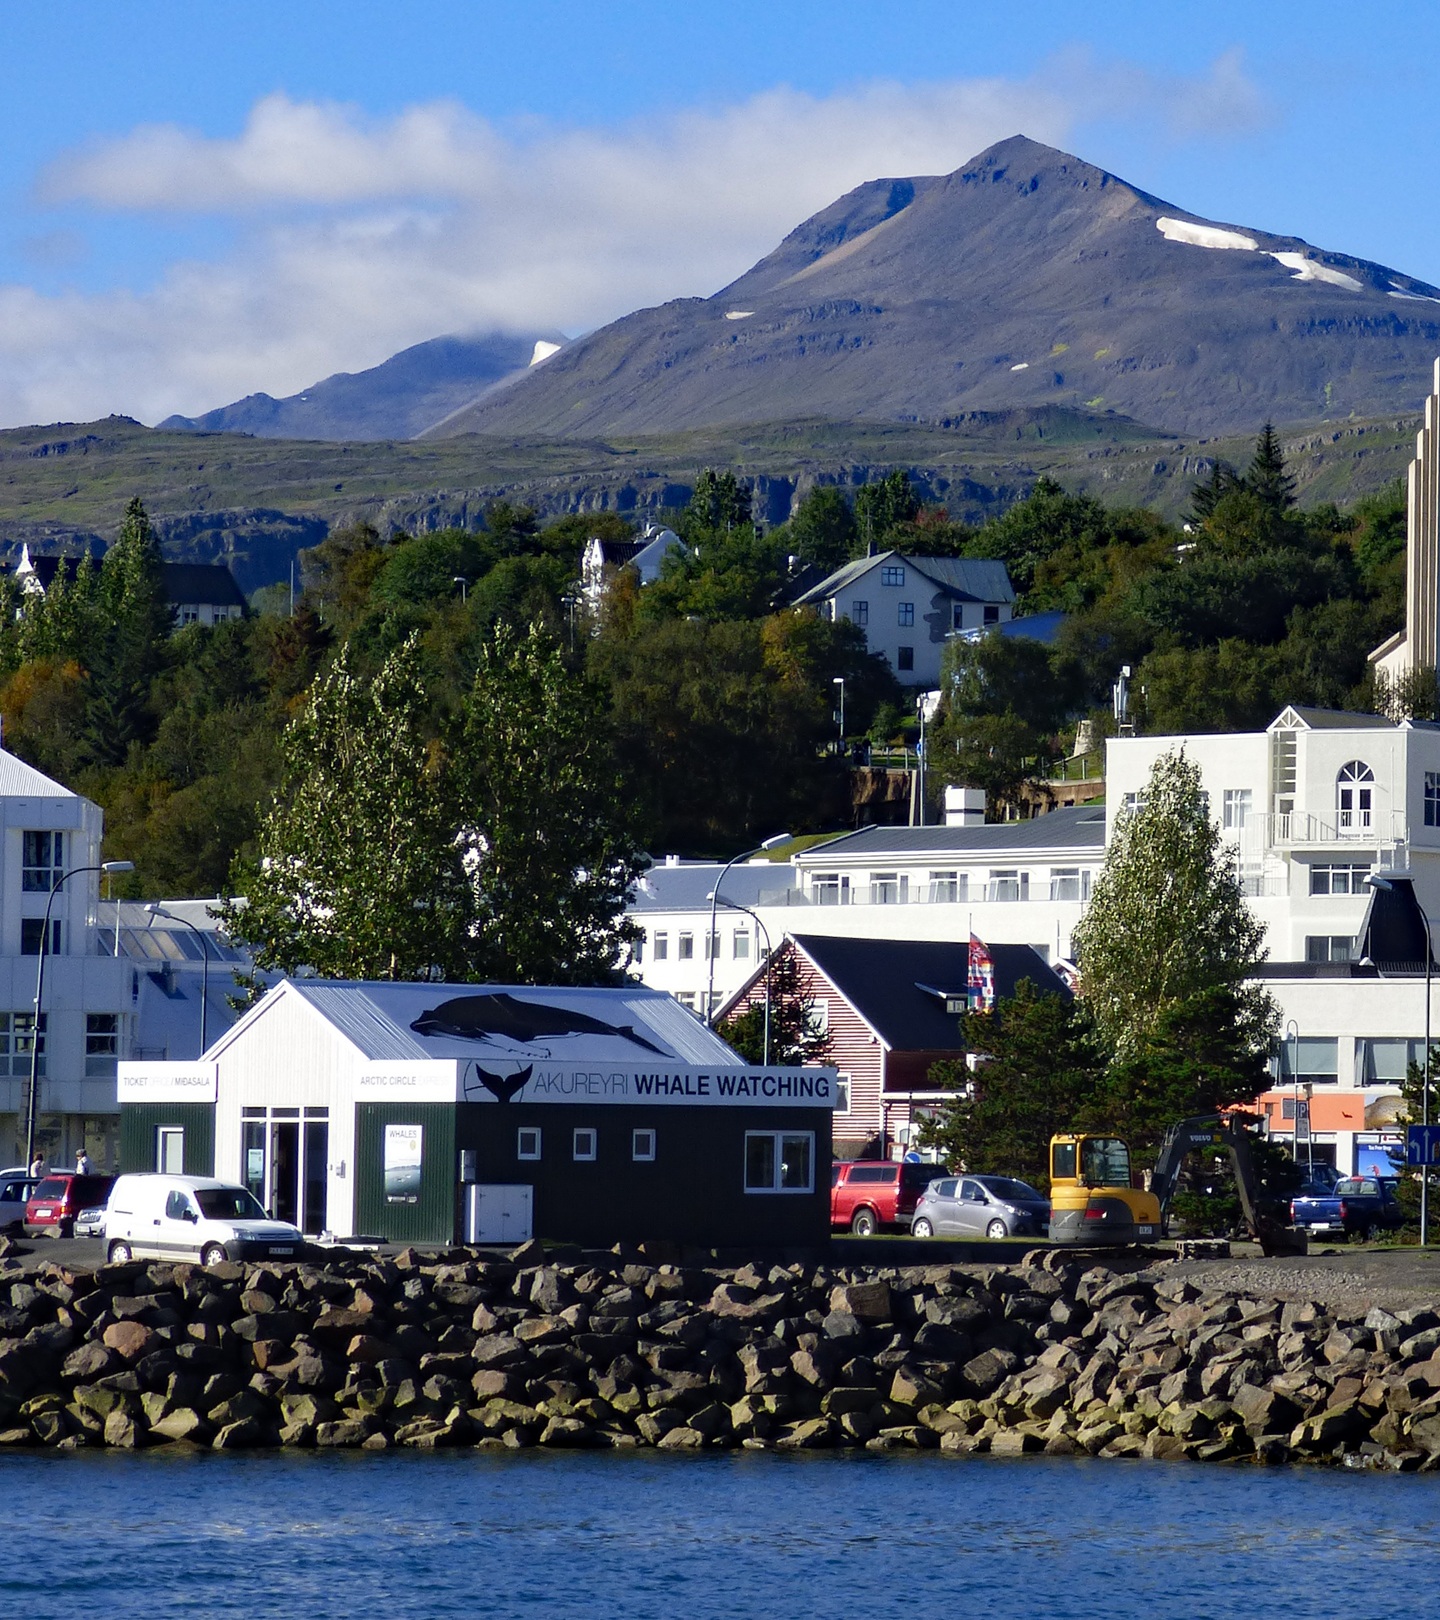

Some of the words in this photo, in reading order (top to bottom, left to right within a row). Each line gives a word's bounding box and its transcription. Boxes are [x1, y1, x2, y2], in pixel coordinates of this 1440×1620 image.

[123, 1077, 148, 1087] TICKET
[360, 1076, 388, 1086] ARCTIC
[389, 1076, 417, 1086] CIRCLE
[533, 1072, 628, 1094] AKUREYRI
[634, 1074, 710, 1095] WHALE
[717, 1075, 830, 1098] WATCHING
[1300, 1103, 1306, 1118] P
[389, 1130, 417, 1138] WHALES
